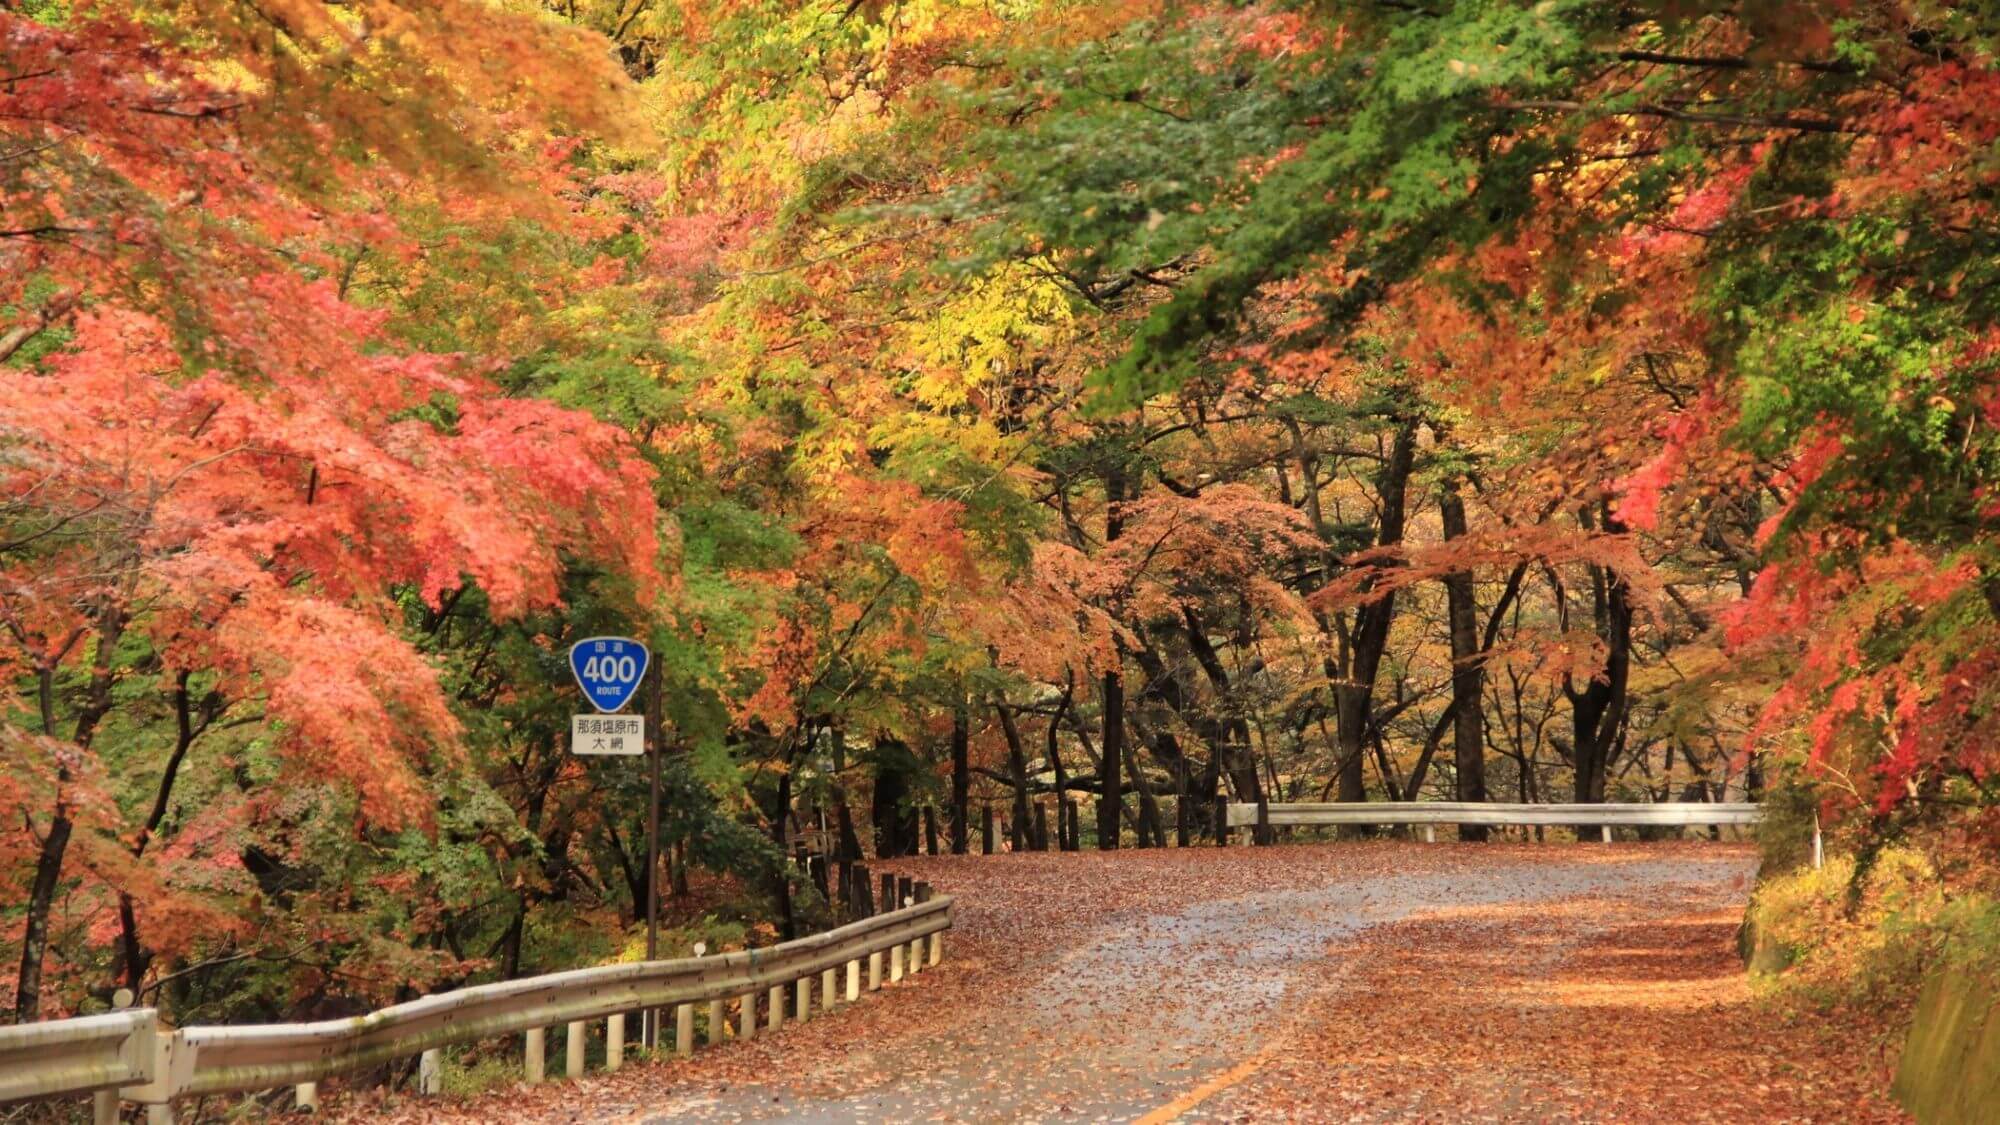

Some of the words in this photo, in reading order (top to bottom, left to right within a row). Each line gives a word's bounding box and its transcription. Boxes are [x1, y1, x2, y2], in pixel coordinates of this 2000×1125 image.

[583, 655, 636, 683] 400
[596, 686, 622, 696] ROUTE
[577, 719, 639, 734] 那須塩原市
